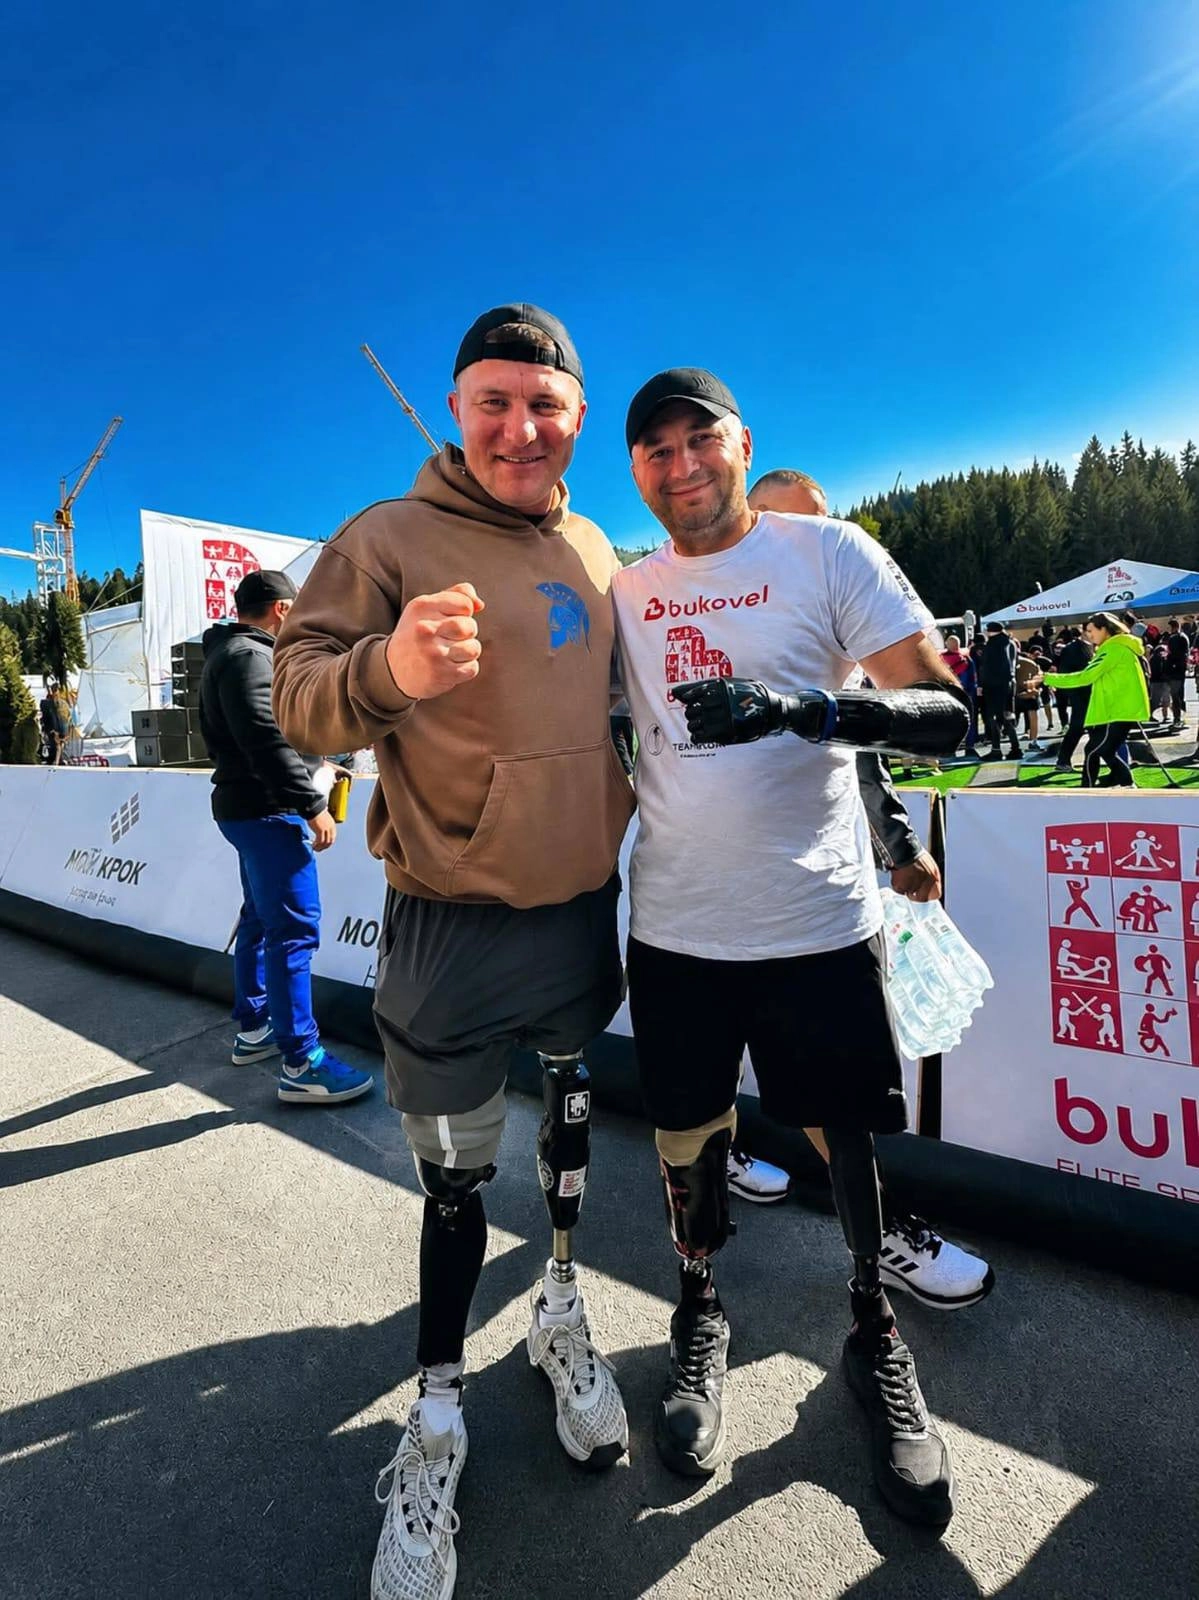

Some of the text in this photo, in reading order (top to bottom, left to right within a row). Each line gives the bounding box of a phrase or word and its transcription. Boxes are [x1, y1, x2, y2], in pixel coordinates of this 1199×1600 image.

[668, 584, 769, 618] bukovel
[1028, 600, 1071, 612] bukovel
[96, 856, 147, 886] КРОК
[336, 915, 381, 949] МО
